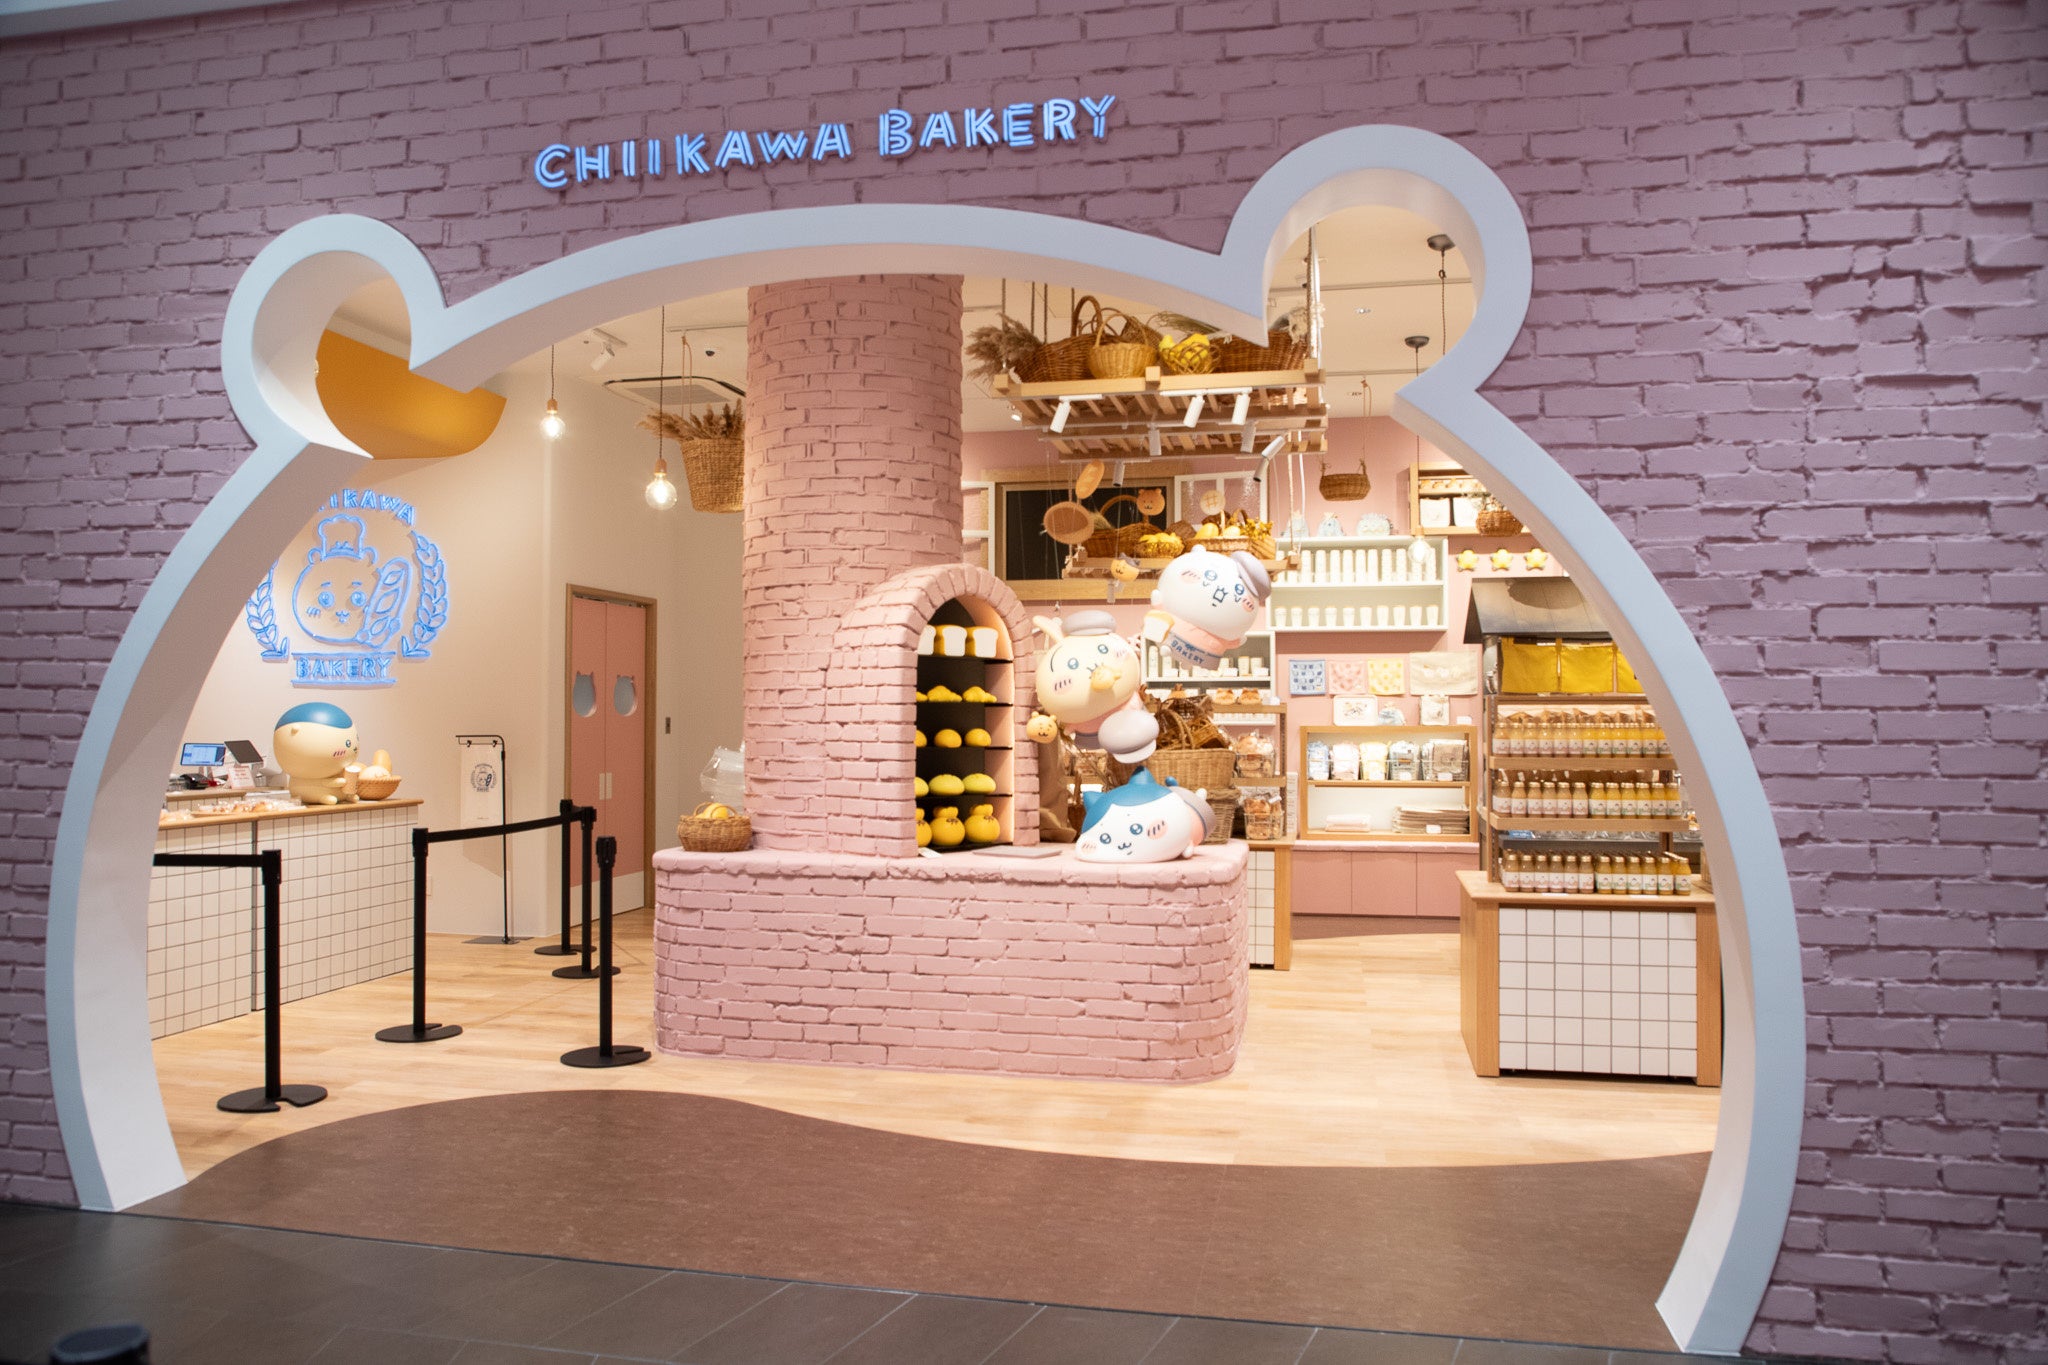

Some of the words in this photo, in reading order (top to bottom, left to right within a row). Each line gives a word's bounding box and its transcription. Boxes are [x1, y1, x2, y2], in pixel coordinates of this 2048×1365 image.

[534, 123, 852, 189] CHIIKAWA
[879, 94, 1116, 157] BAKERY
[318, 488, 416, 526] IKAWA
[296, 657, 392, 678] BAKERY
[1171, 639, 1205, 665] BAKERY
